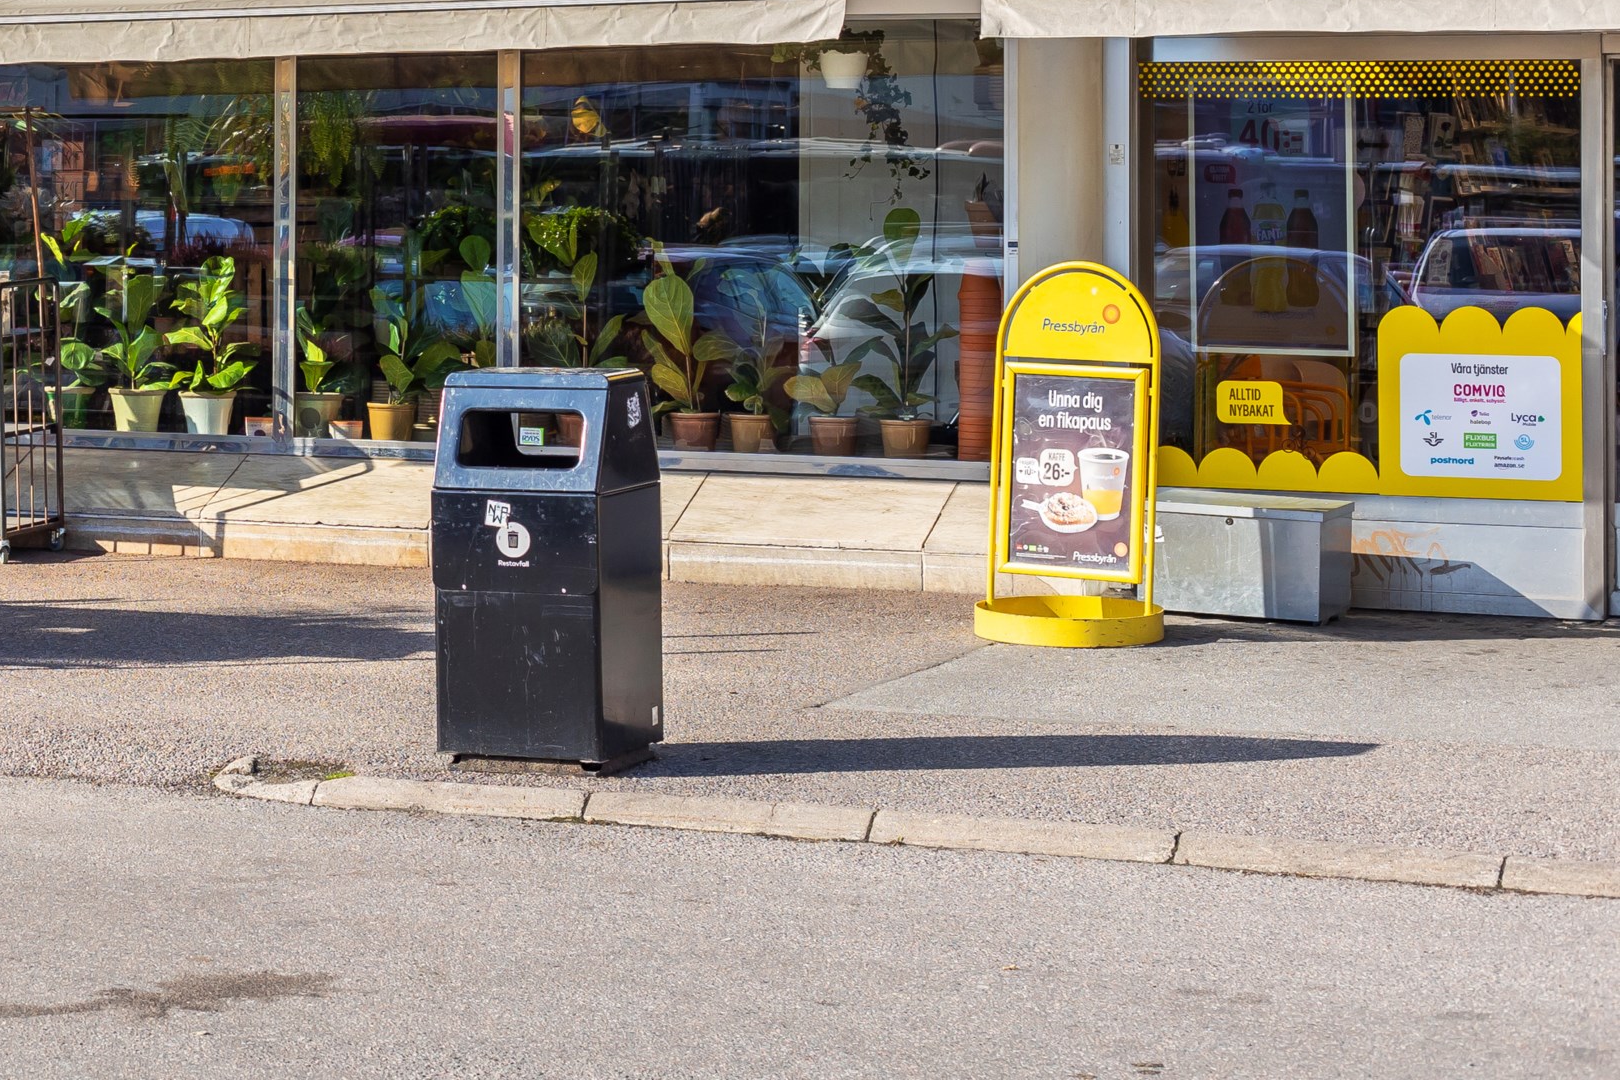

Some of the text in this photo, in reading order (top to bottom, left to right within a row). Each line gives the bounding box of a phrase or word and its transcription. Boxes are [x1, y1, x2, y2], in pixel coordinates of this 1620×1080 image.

[1042, 318, 1105, 335] Pressbyrån
[1451, 363, 1508, 376] Våra tjänster
[1229, 388, 1261, 401] ALLTID
[1453, 384, 1506, 397] COMVIQ
[1048, 390, 1103, 413] Unna dig
[1229, 404, 1274, 417] NYBAKAT
[1038, 411, 1111, 433] en fikapaus
[1511, 413, 1536, 423] Lyca
[1430, 457, 1474, 465] postnord
[497, 559, 530, 567] Restavfall
[1073, 551, 1117, 565] Pressbyrån
